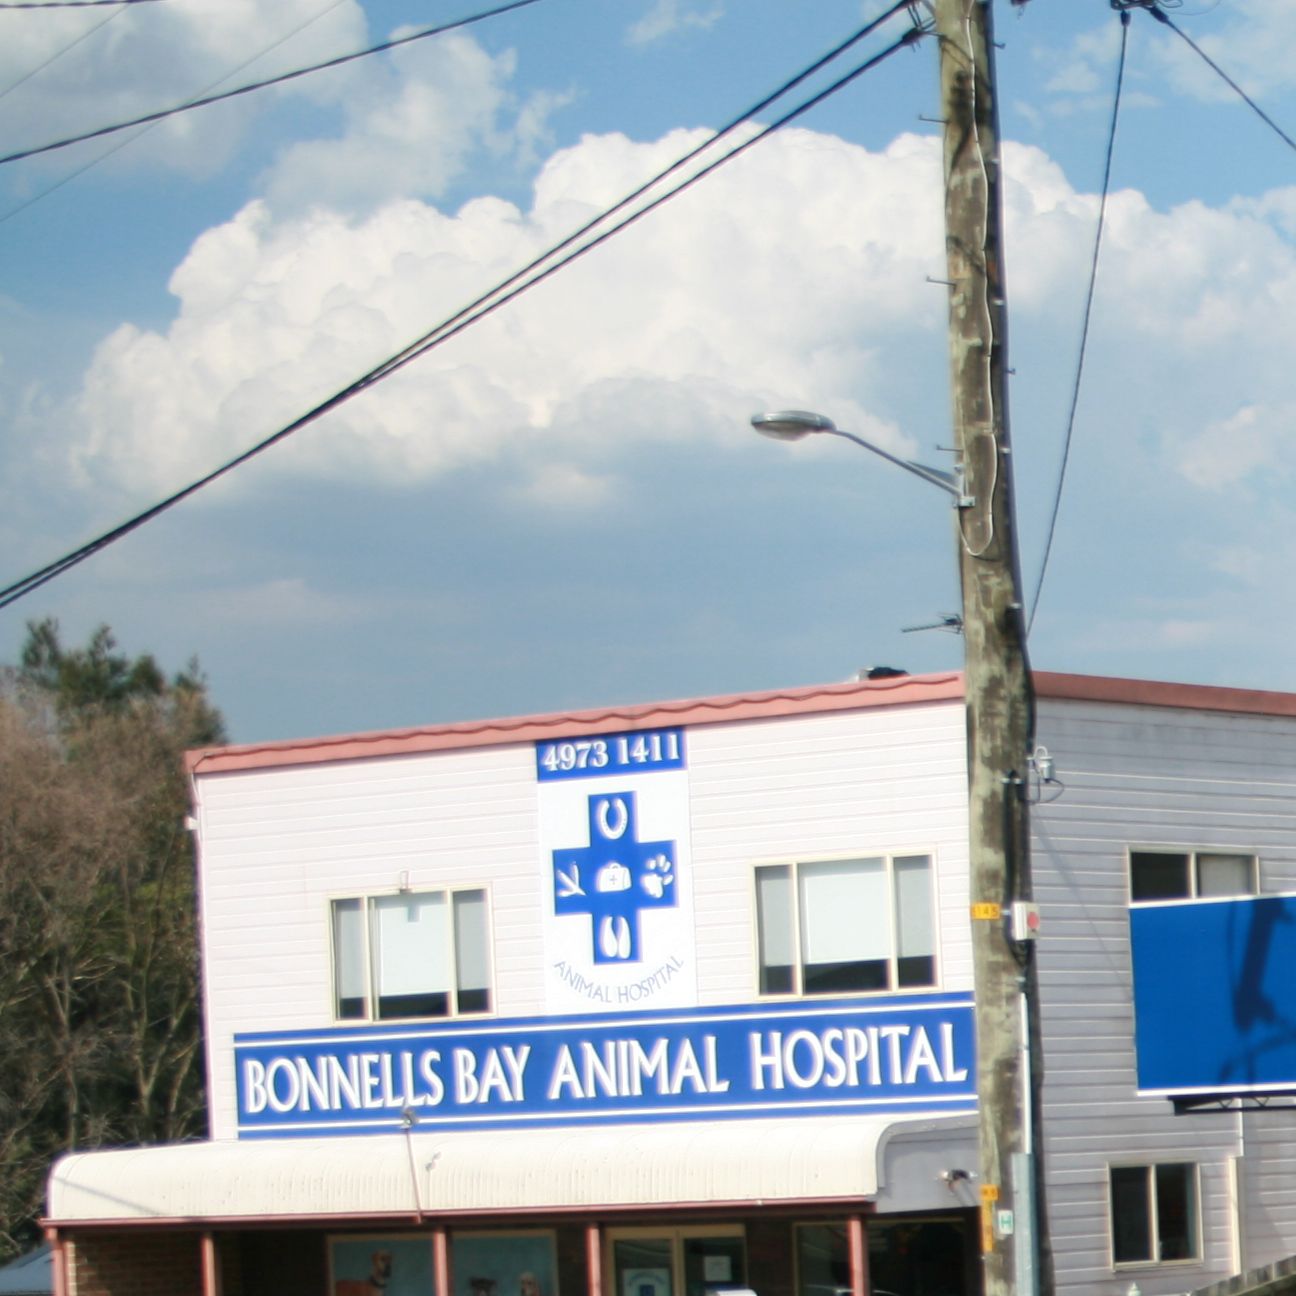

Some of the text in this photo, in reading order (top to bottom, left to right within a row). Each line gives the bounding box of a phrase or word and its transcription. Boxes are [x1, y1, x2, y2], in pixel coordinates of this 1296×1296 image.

[542, 734, 681, 772] 4973 1411
[553, 955, 685, 1004] ANIMAL HOSPITAL
[245, 1022, 969, 1114] BONNELLS BAY ANIMAL HOSPITAL
